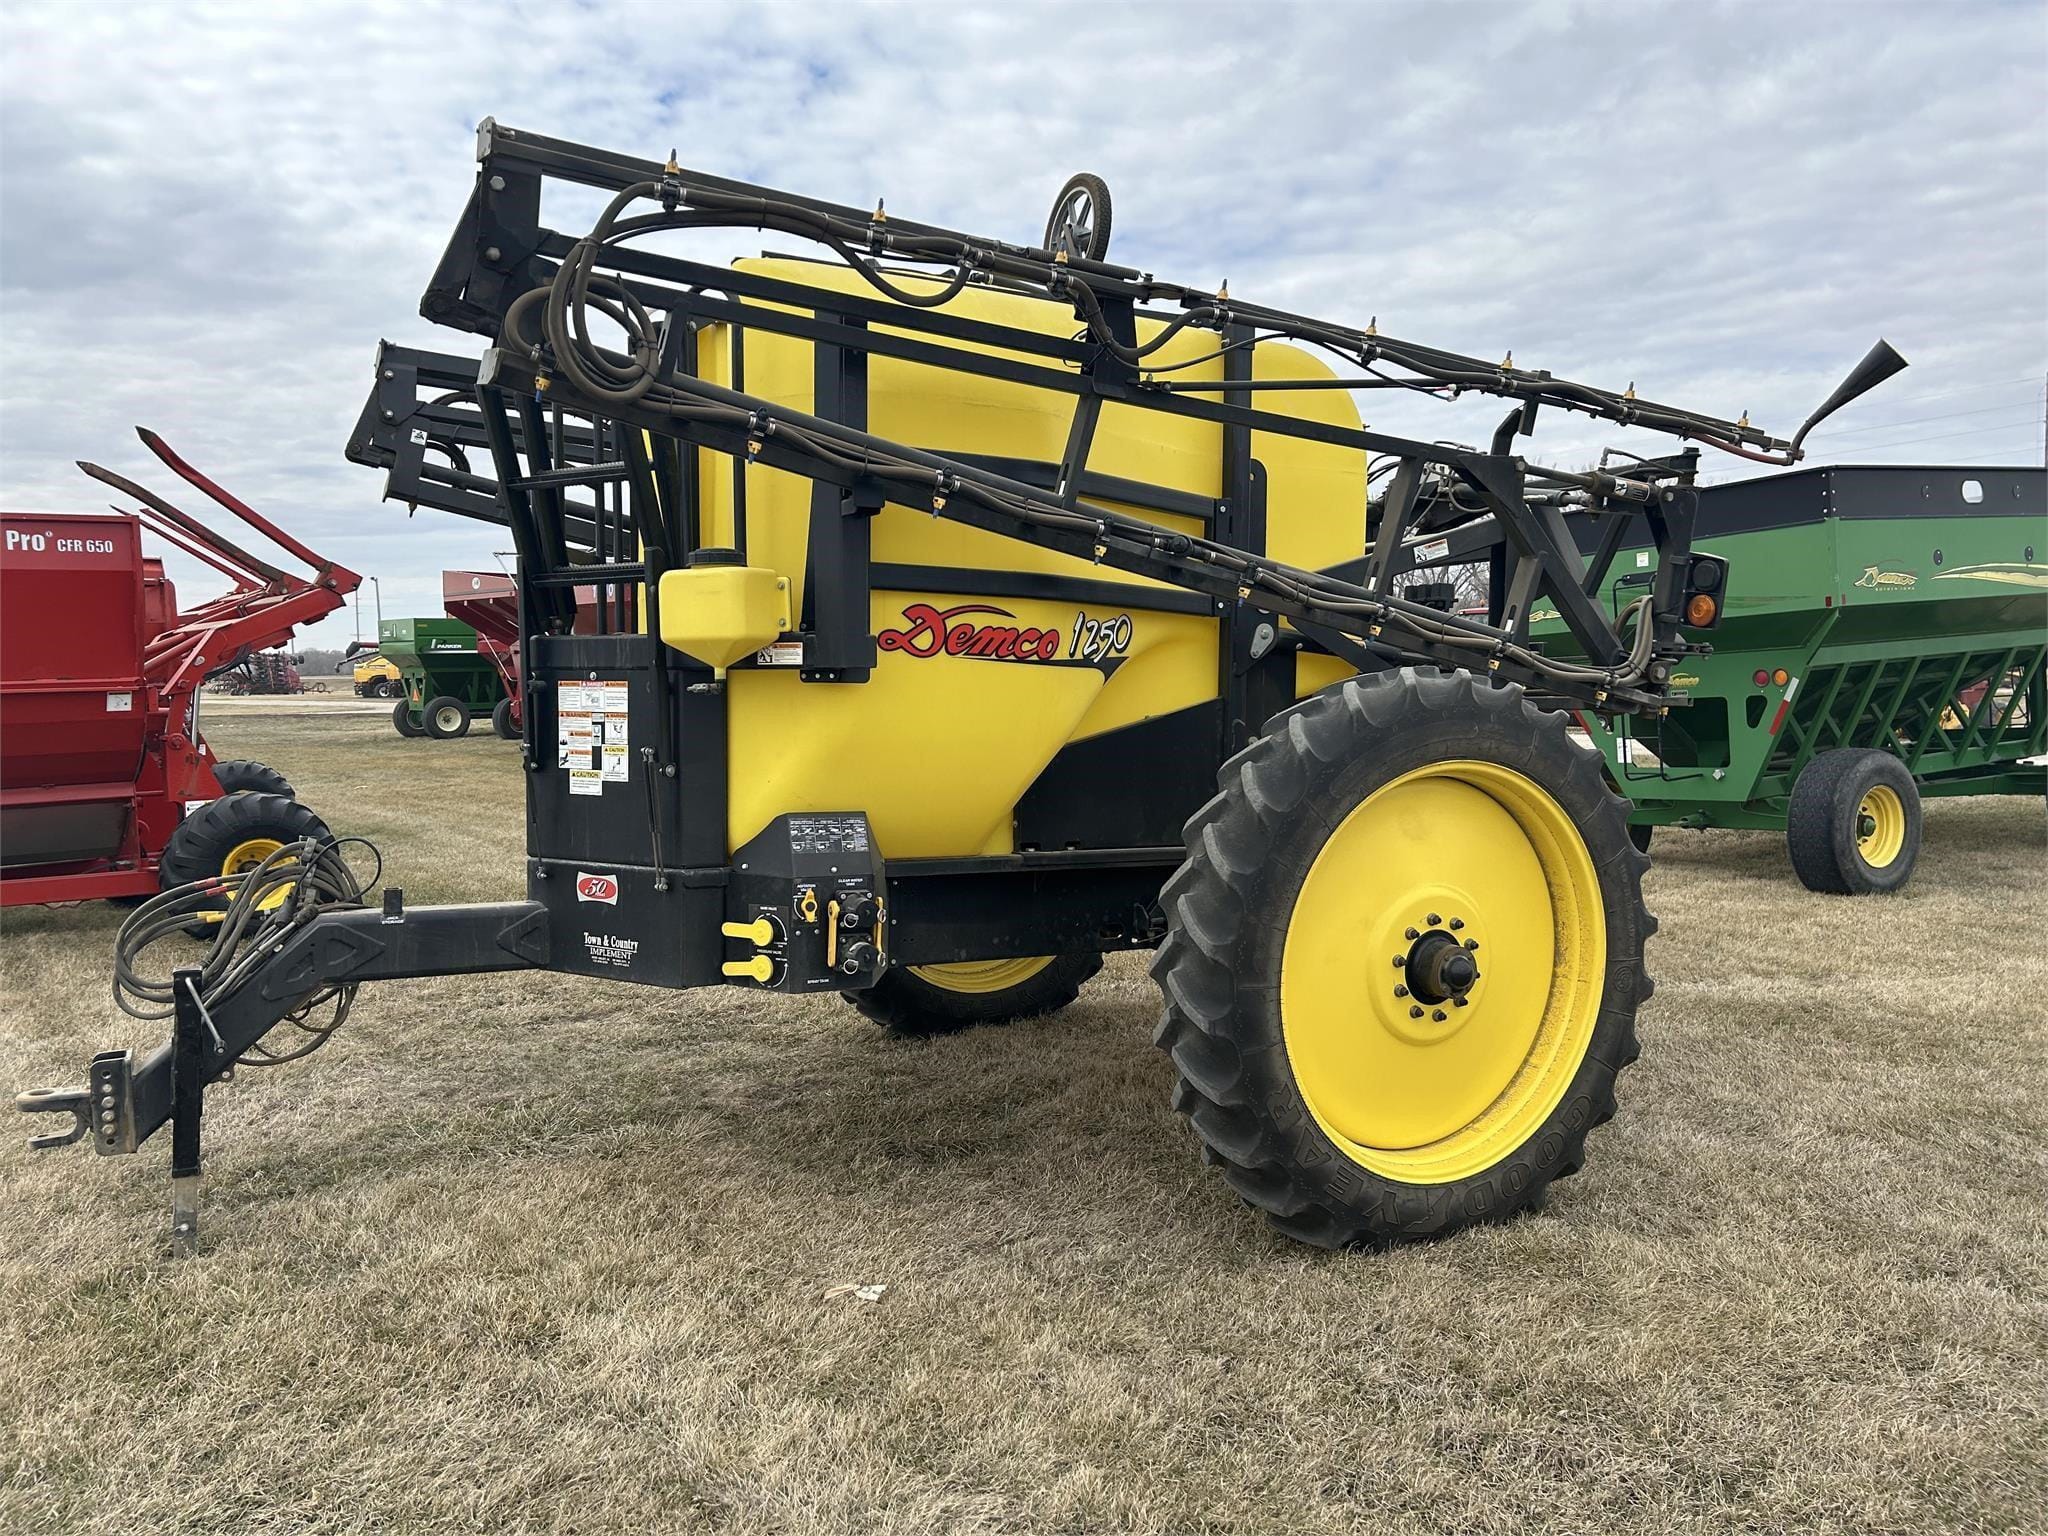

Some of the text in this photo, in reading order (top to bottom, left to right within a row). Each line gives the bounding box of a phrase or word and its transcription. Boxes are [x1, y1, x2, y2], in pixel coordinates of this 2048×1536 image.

[5, 529, 113, 553] Pro CFR 650
[877, 603, 1133, 663] Demco 1250
[585, 879, 607, 896] 50
[583, 932, 639, 953] Town & Country
[590, 947, 633, 960] IMPLEMENT
[1266, 1082, 1593, 1232] GOODYEAR
